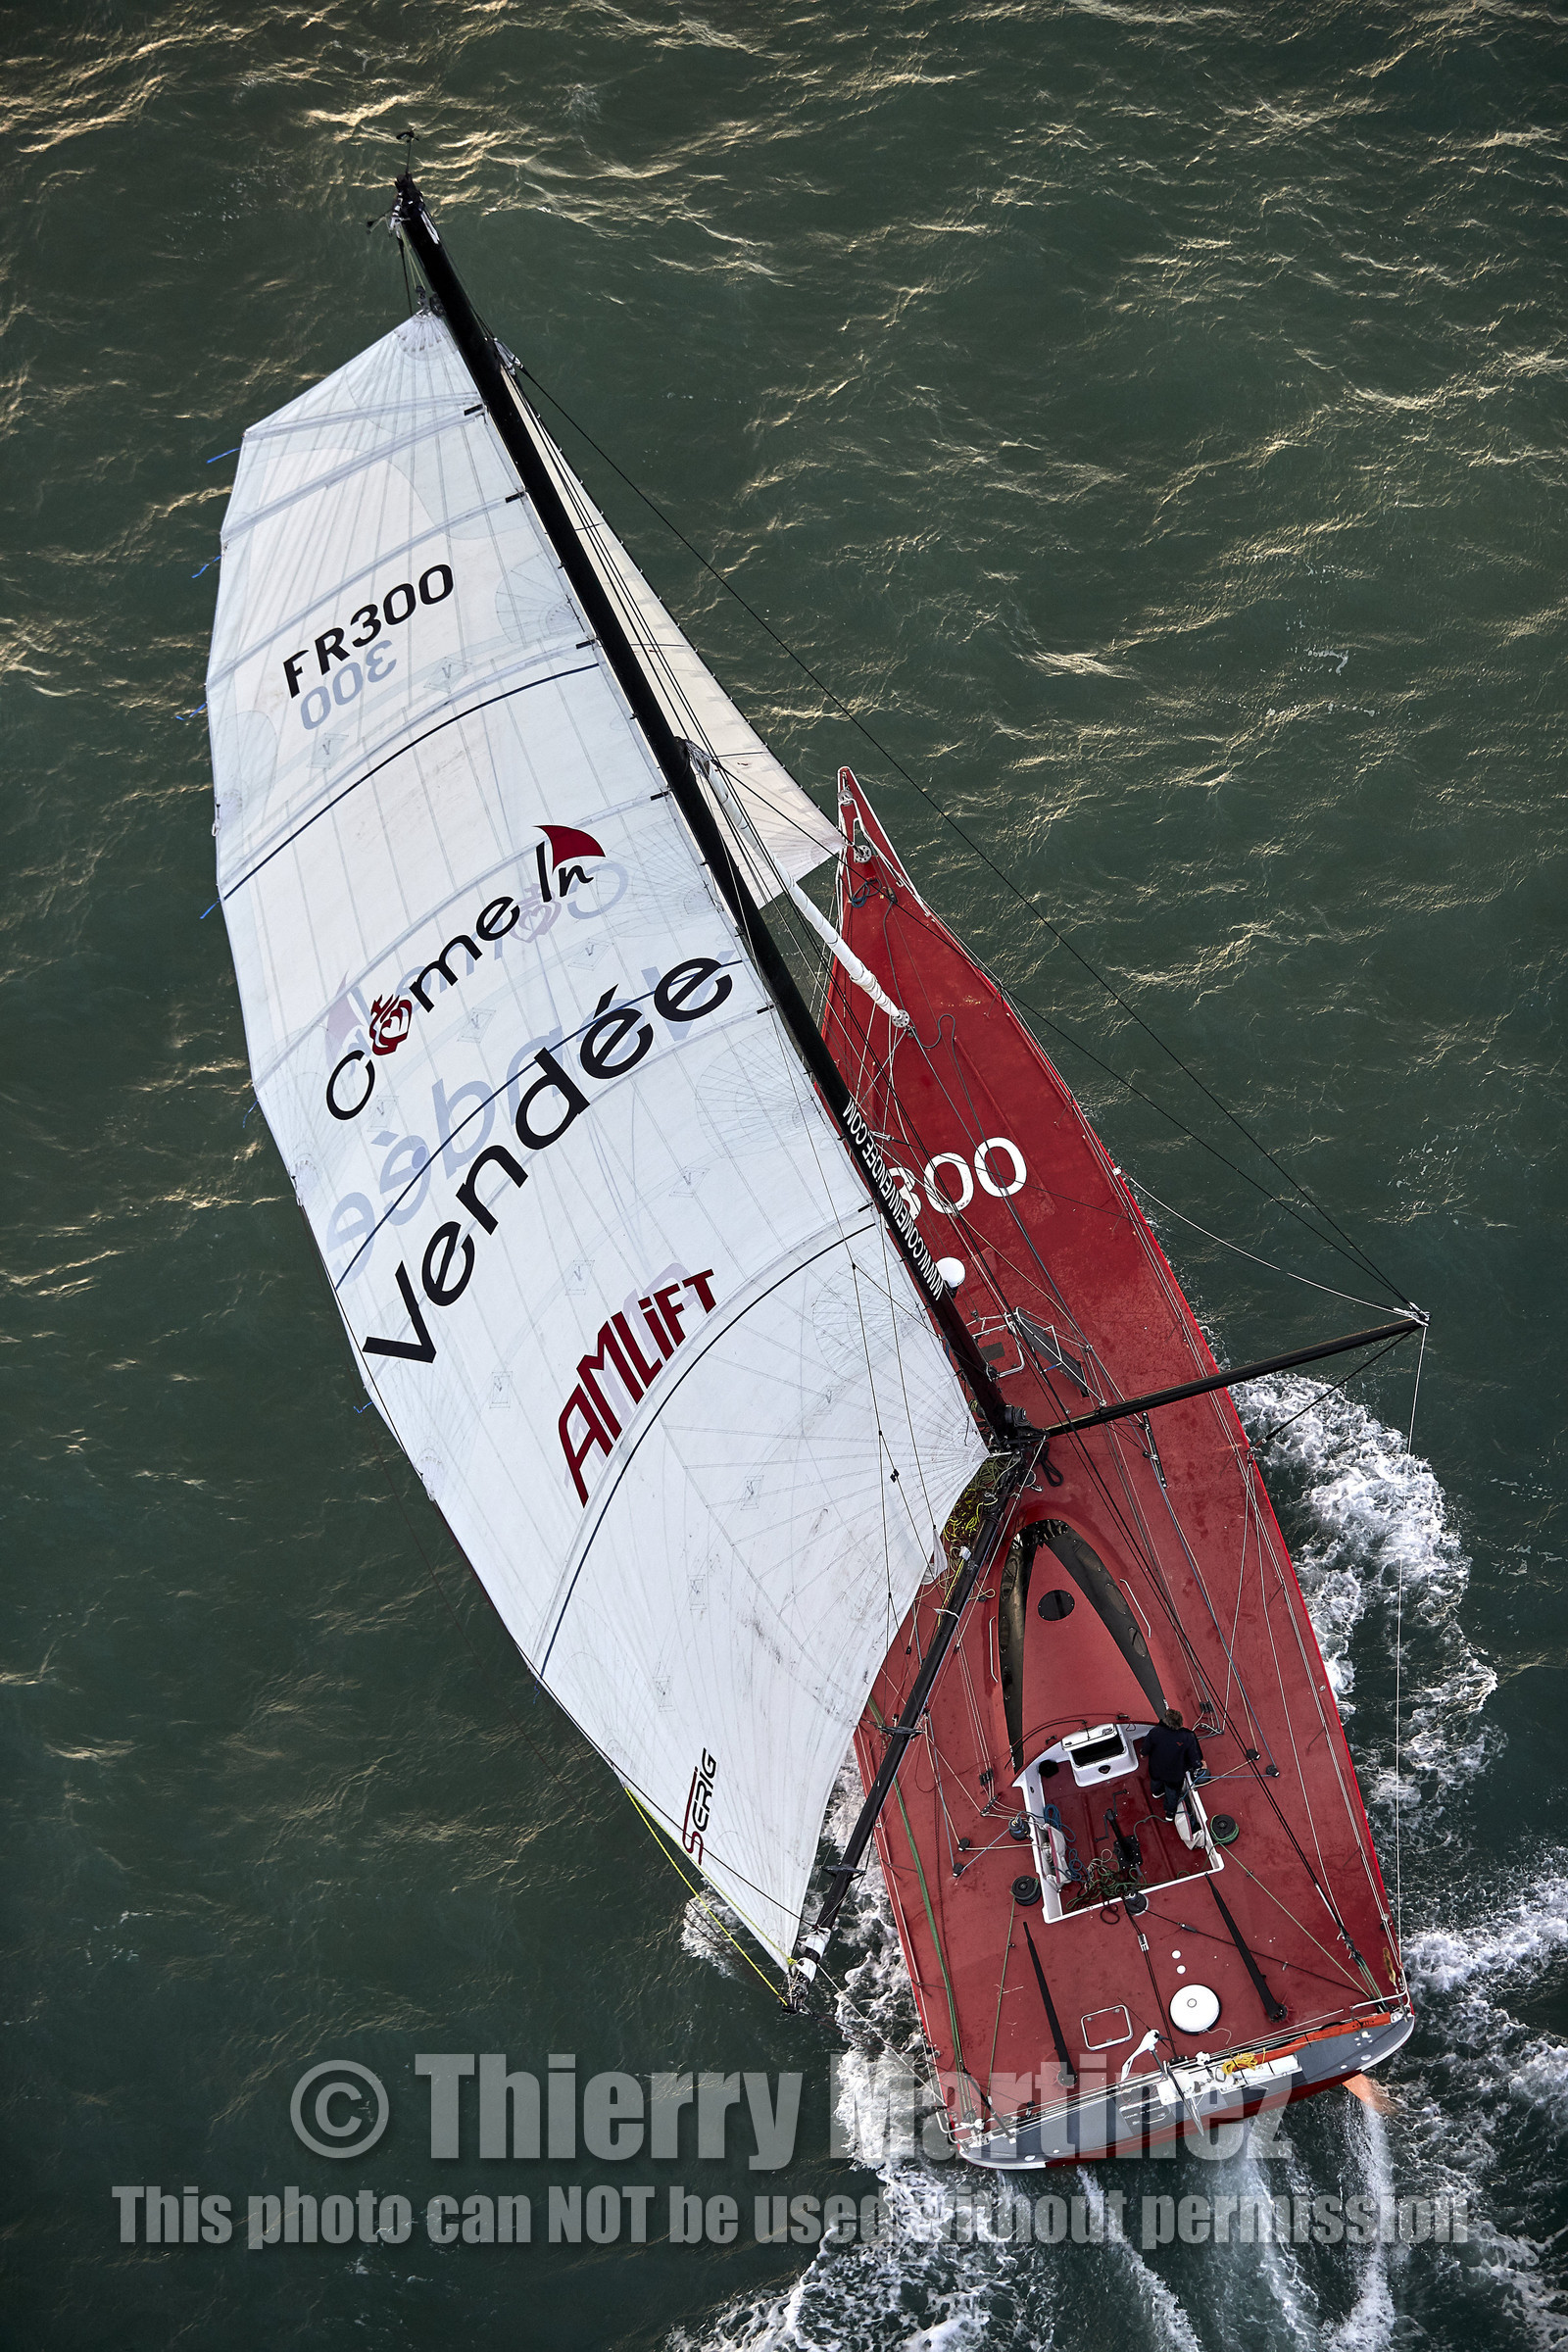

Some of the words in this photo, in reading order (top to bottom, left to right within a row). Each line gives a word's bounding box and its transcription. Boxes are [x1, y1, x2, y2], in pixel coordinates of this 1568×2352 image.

[536, 839, 594, 903] In
[362, 957, 732, 1363] Vendée
[842, 1097, 945, 1300] WWW.COMEINVENDEE.COM
